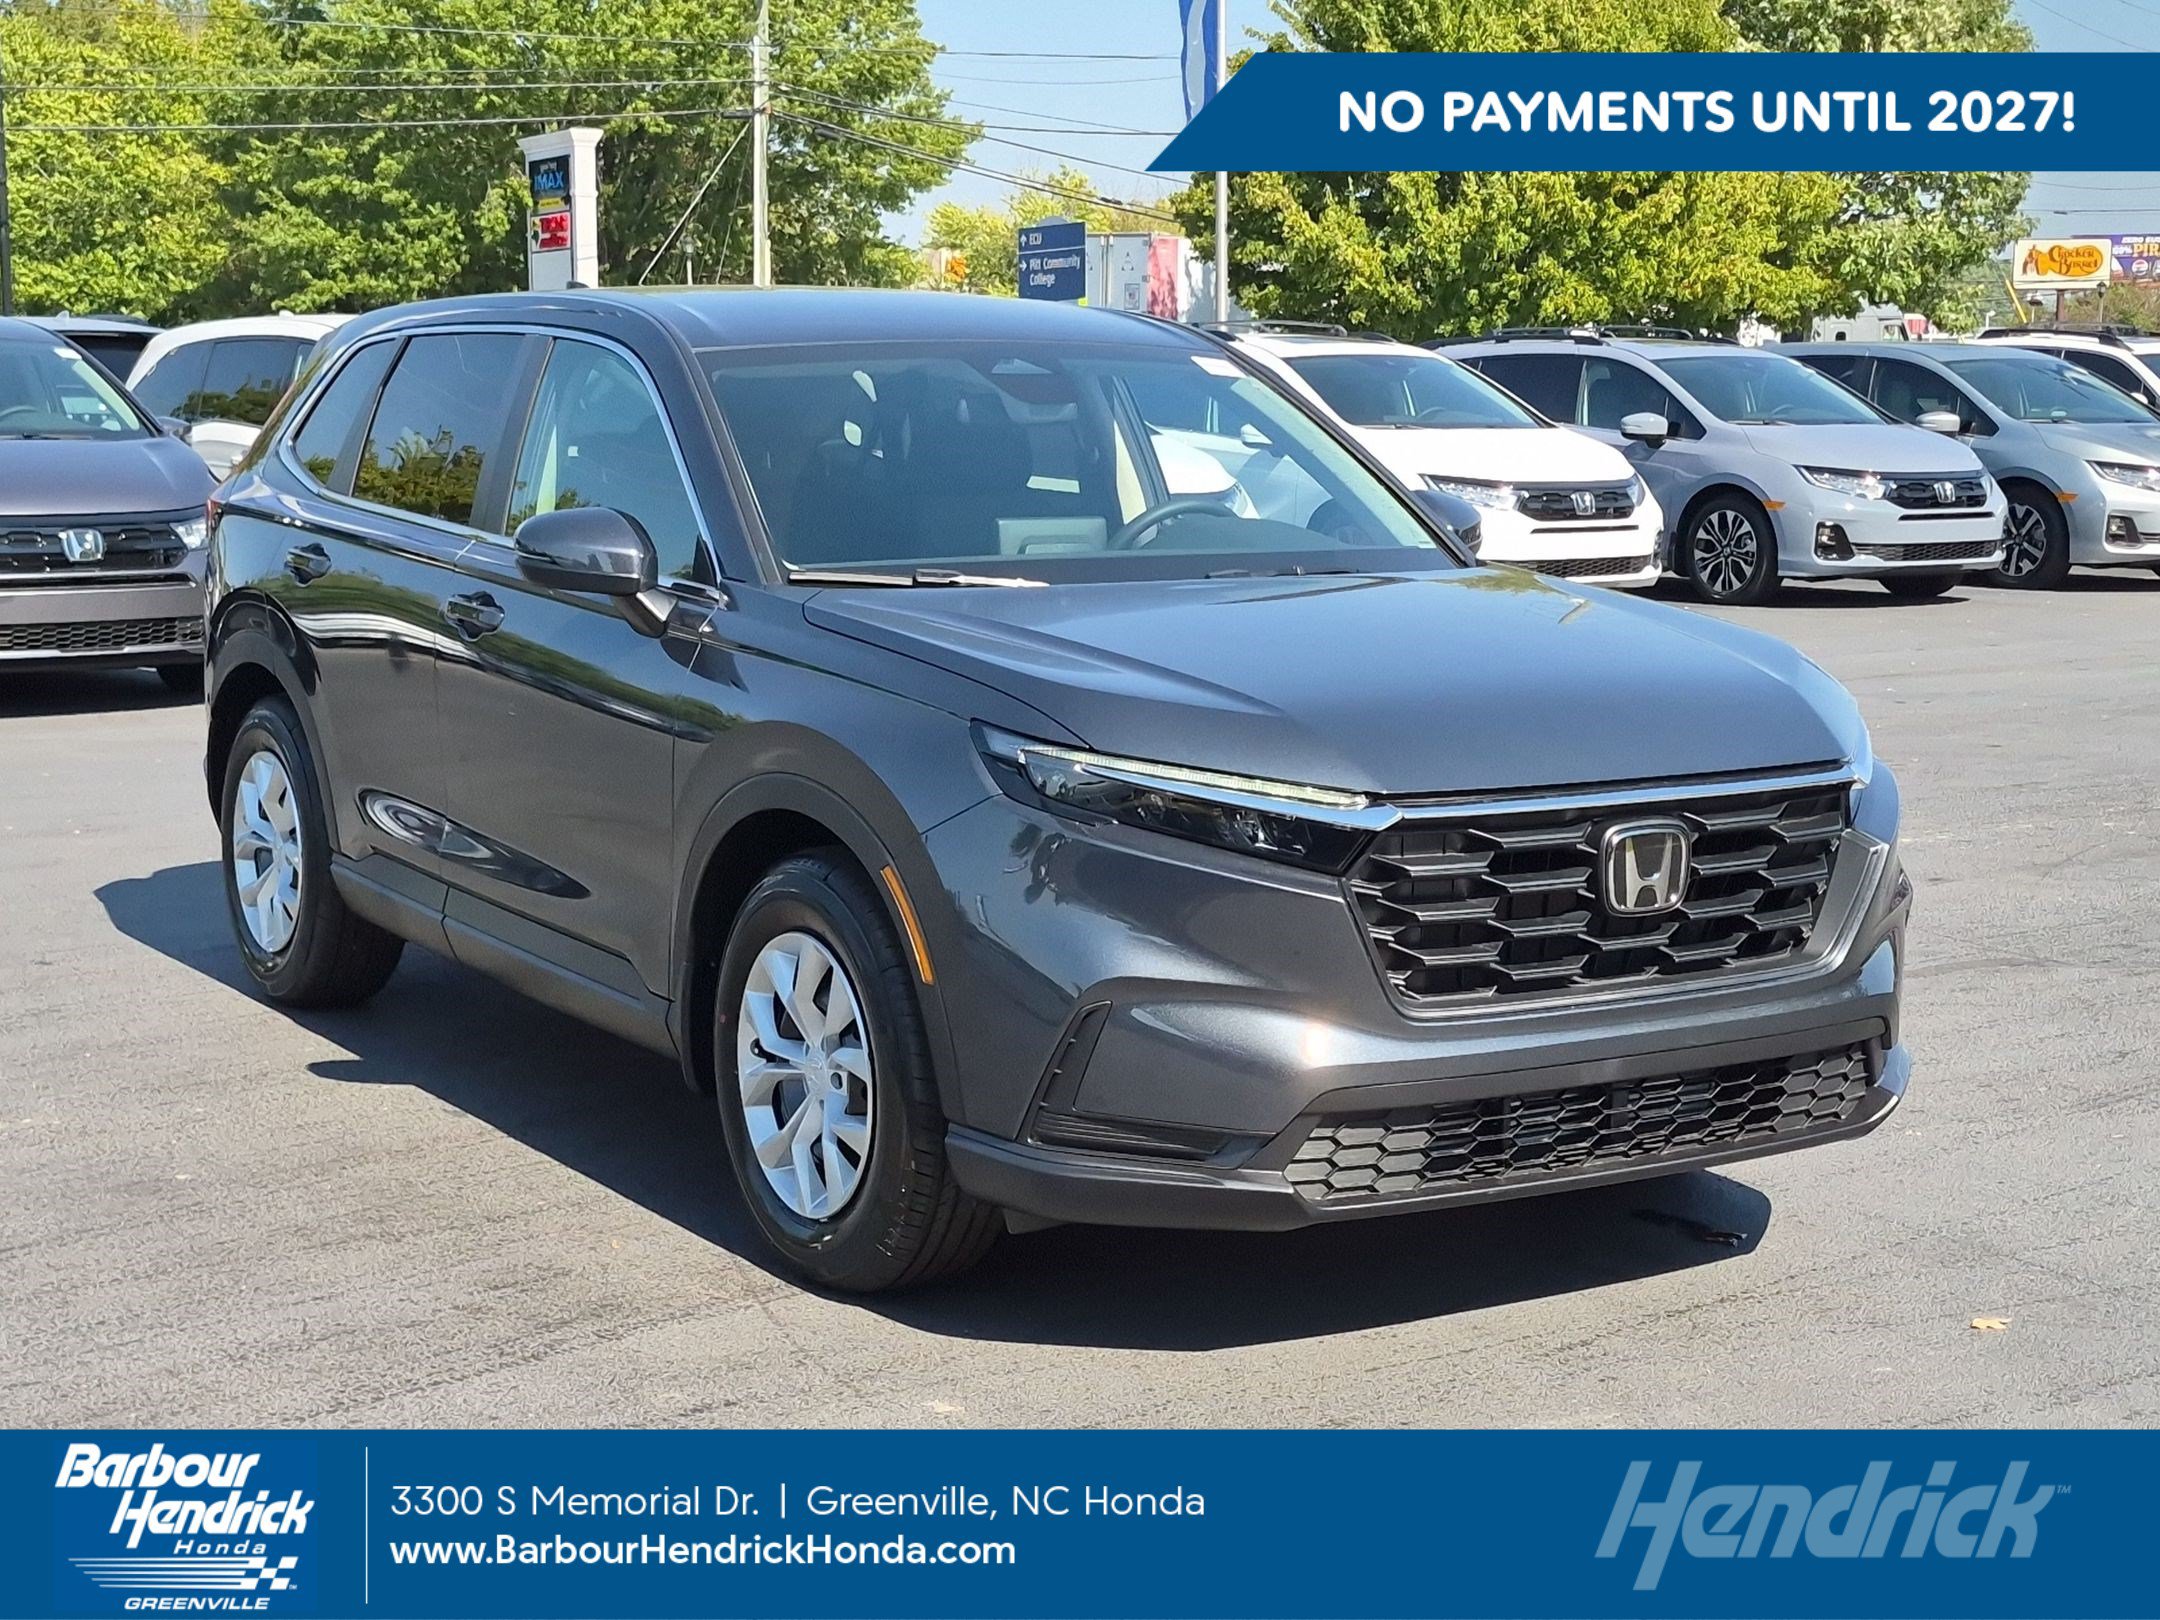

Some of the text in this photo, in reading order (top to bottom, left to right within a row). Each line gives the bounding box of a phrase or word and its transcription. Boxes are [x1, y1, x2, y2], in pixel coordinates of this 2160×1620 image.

[534, 171, 564, 191] IMAX
[1029, 233, 1042, 245] ECU
[1043, 255, 1080, 270] Community
[1030, 273, 1056, 288] College
